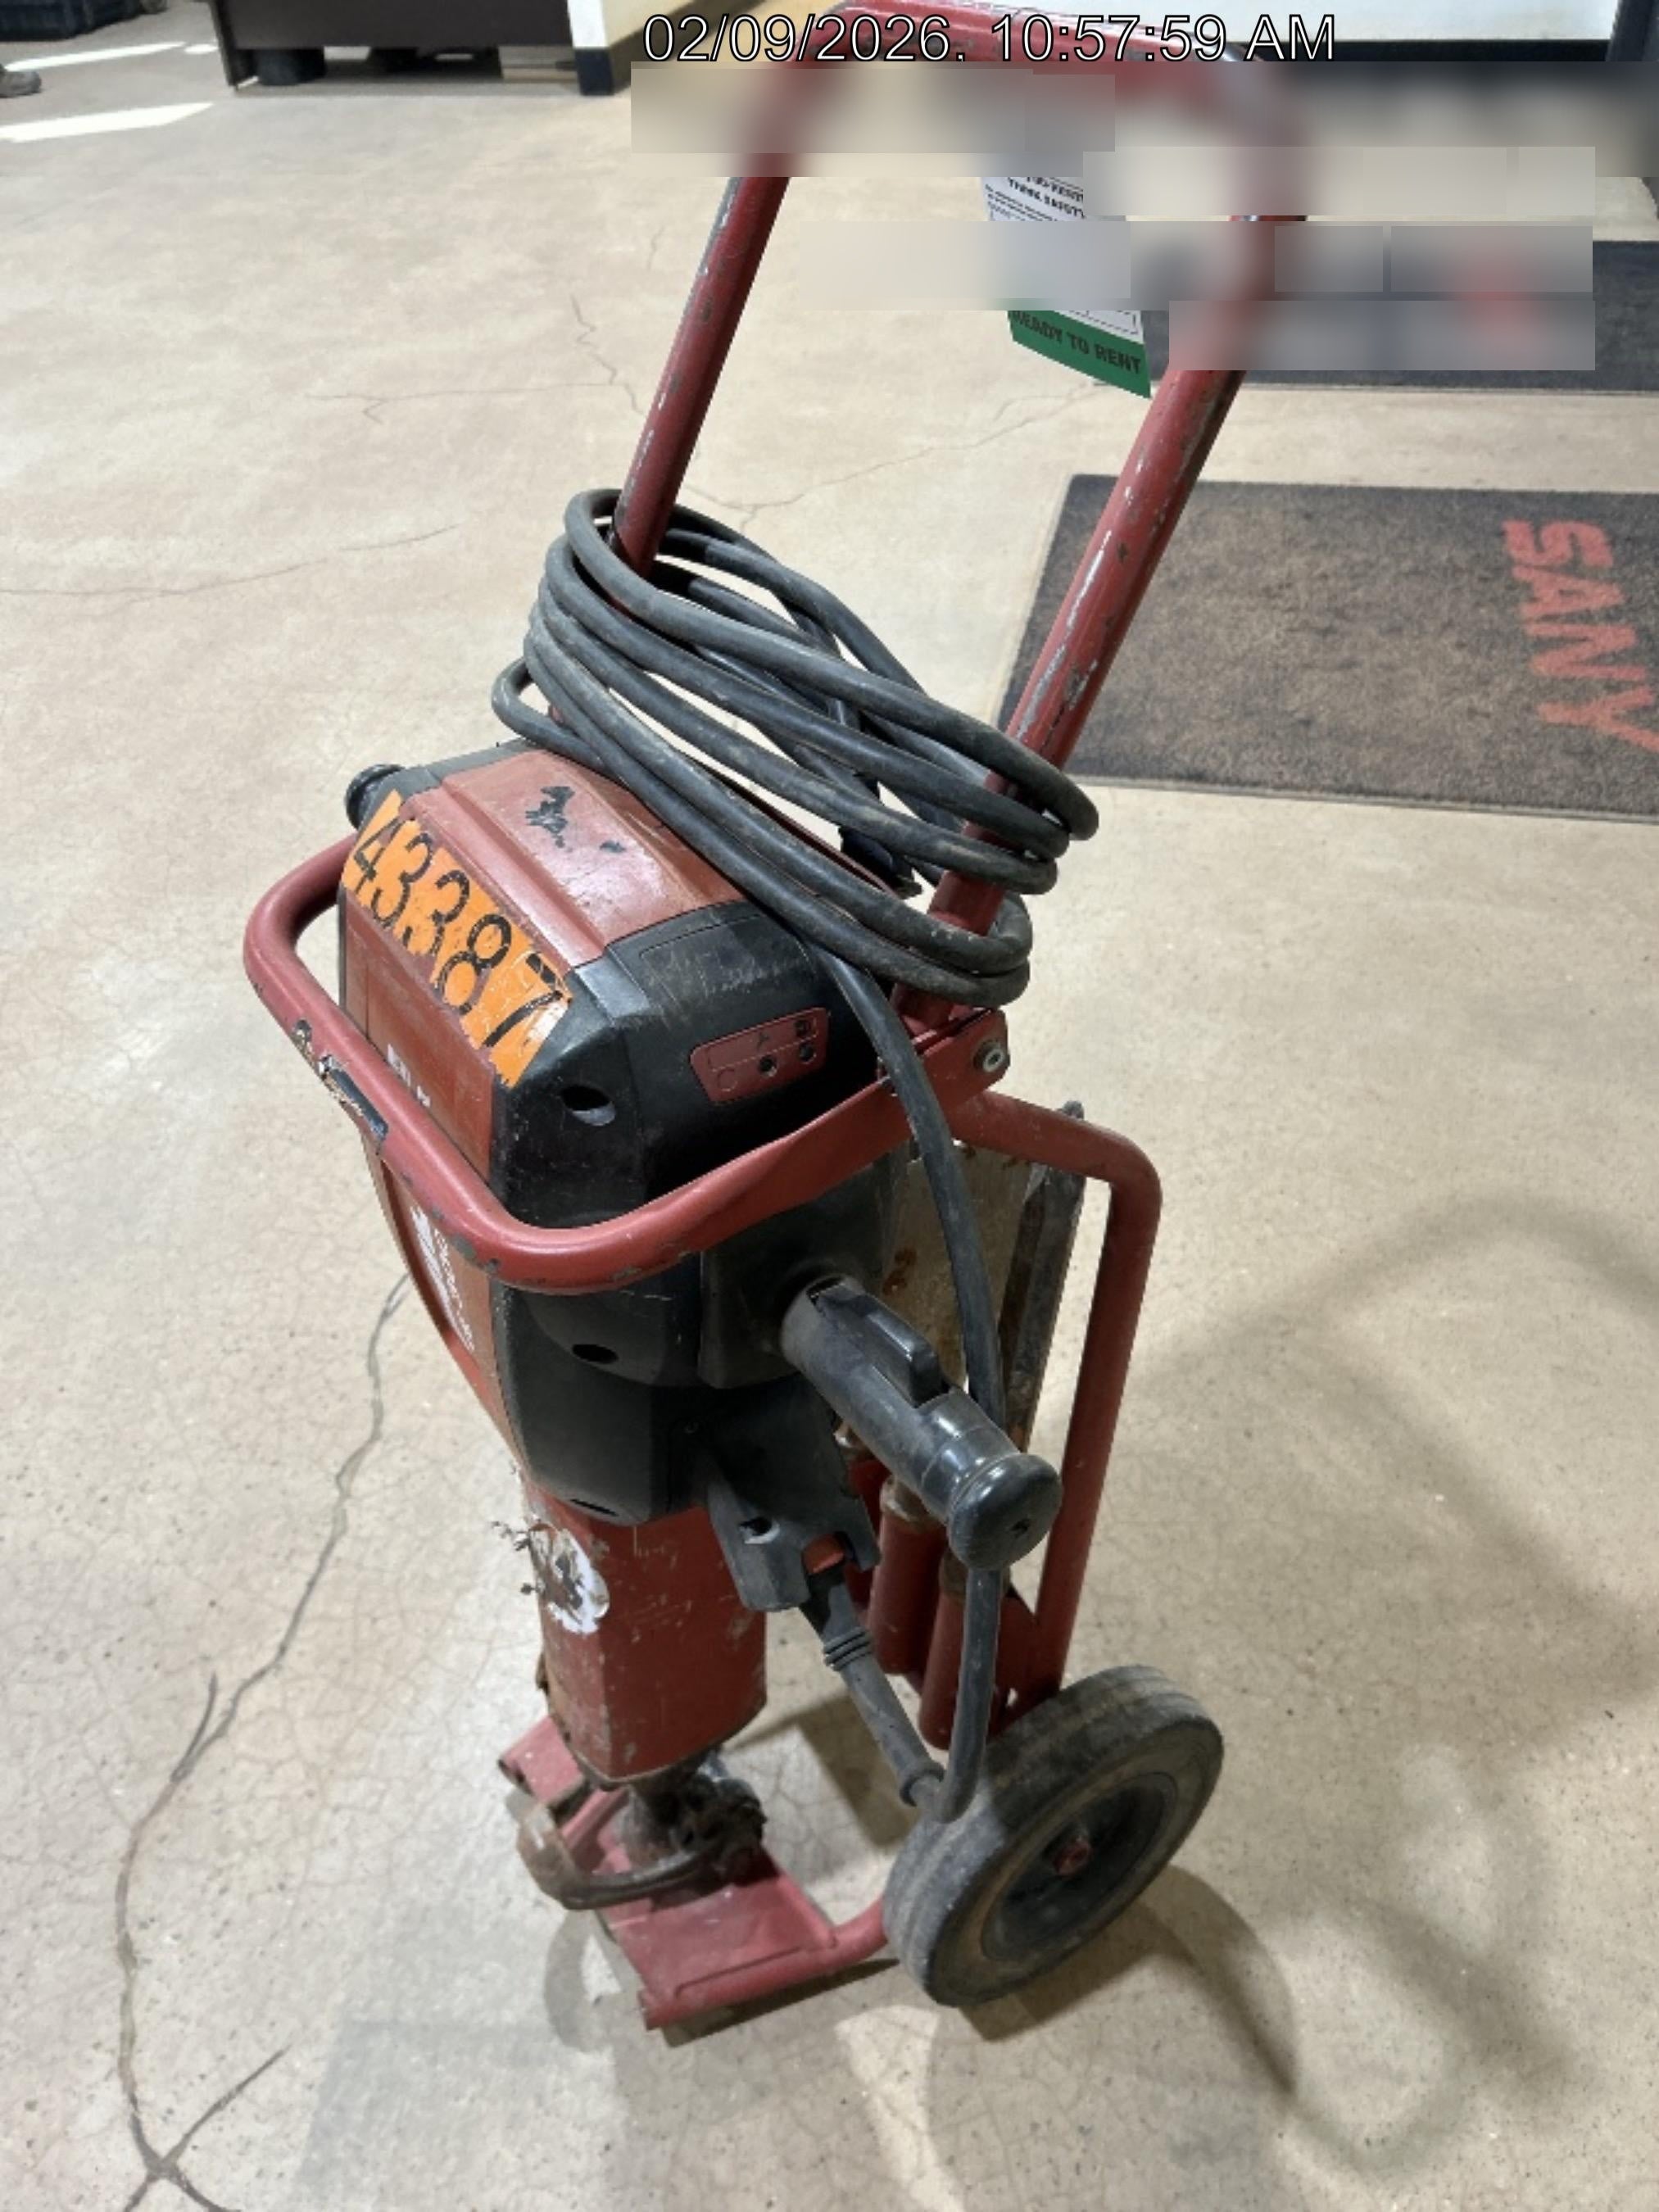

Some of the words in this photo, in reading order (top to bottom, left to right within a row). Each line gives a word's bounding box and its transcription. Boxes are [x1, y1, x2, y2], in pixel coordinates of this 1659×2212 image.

[1067, 331, 1090, 355] TO
[1095, 343, 1141, 374] RENT
[1502, 519, 1659, 753] SANY
[354, 817, 573, 1048] 43387
